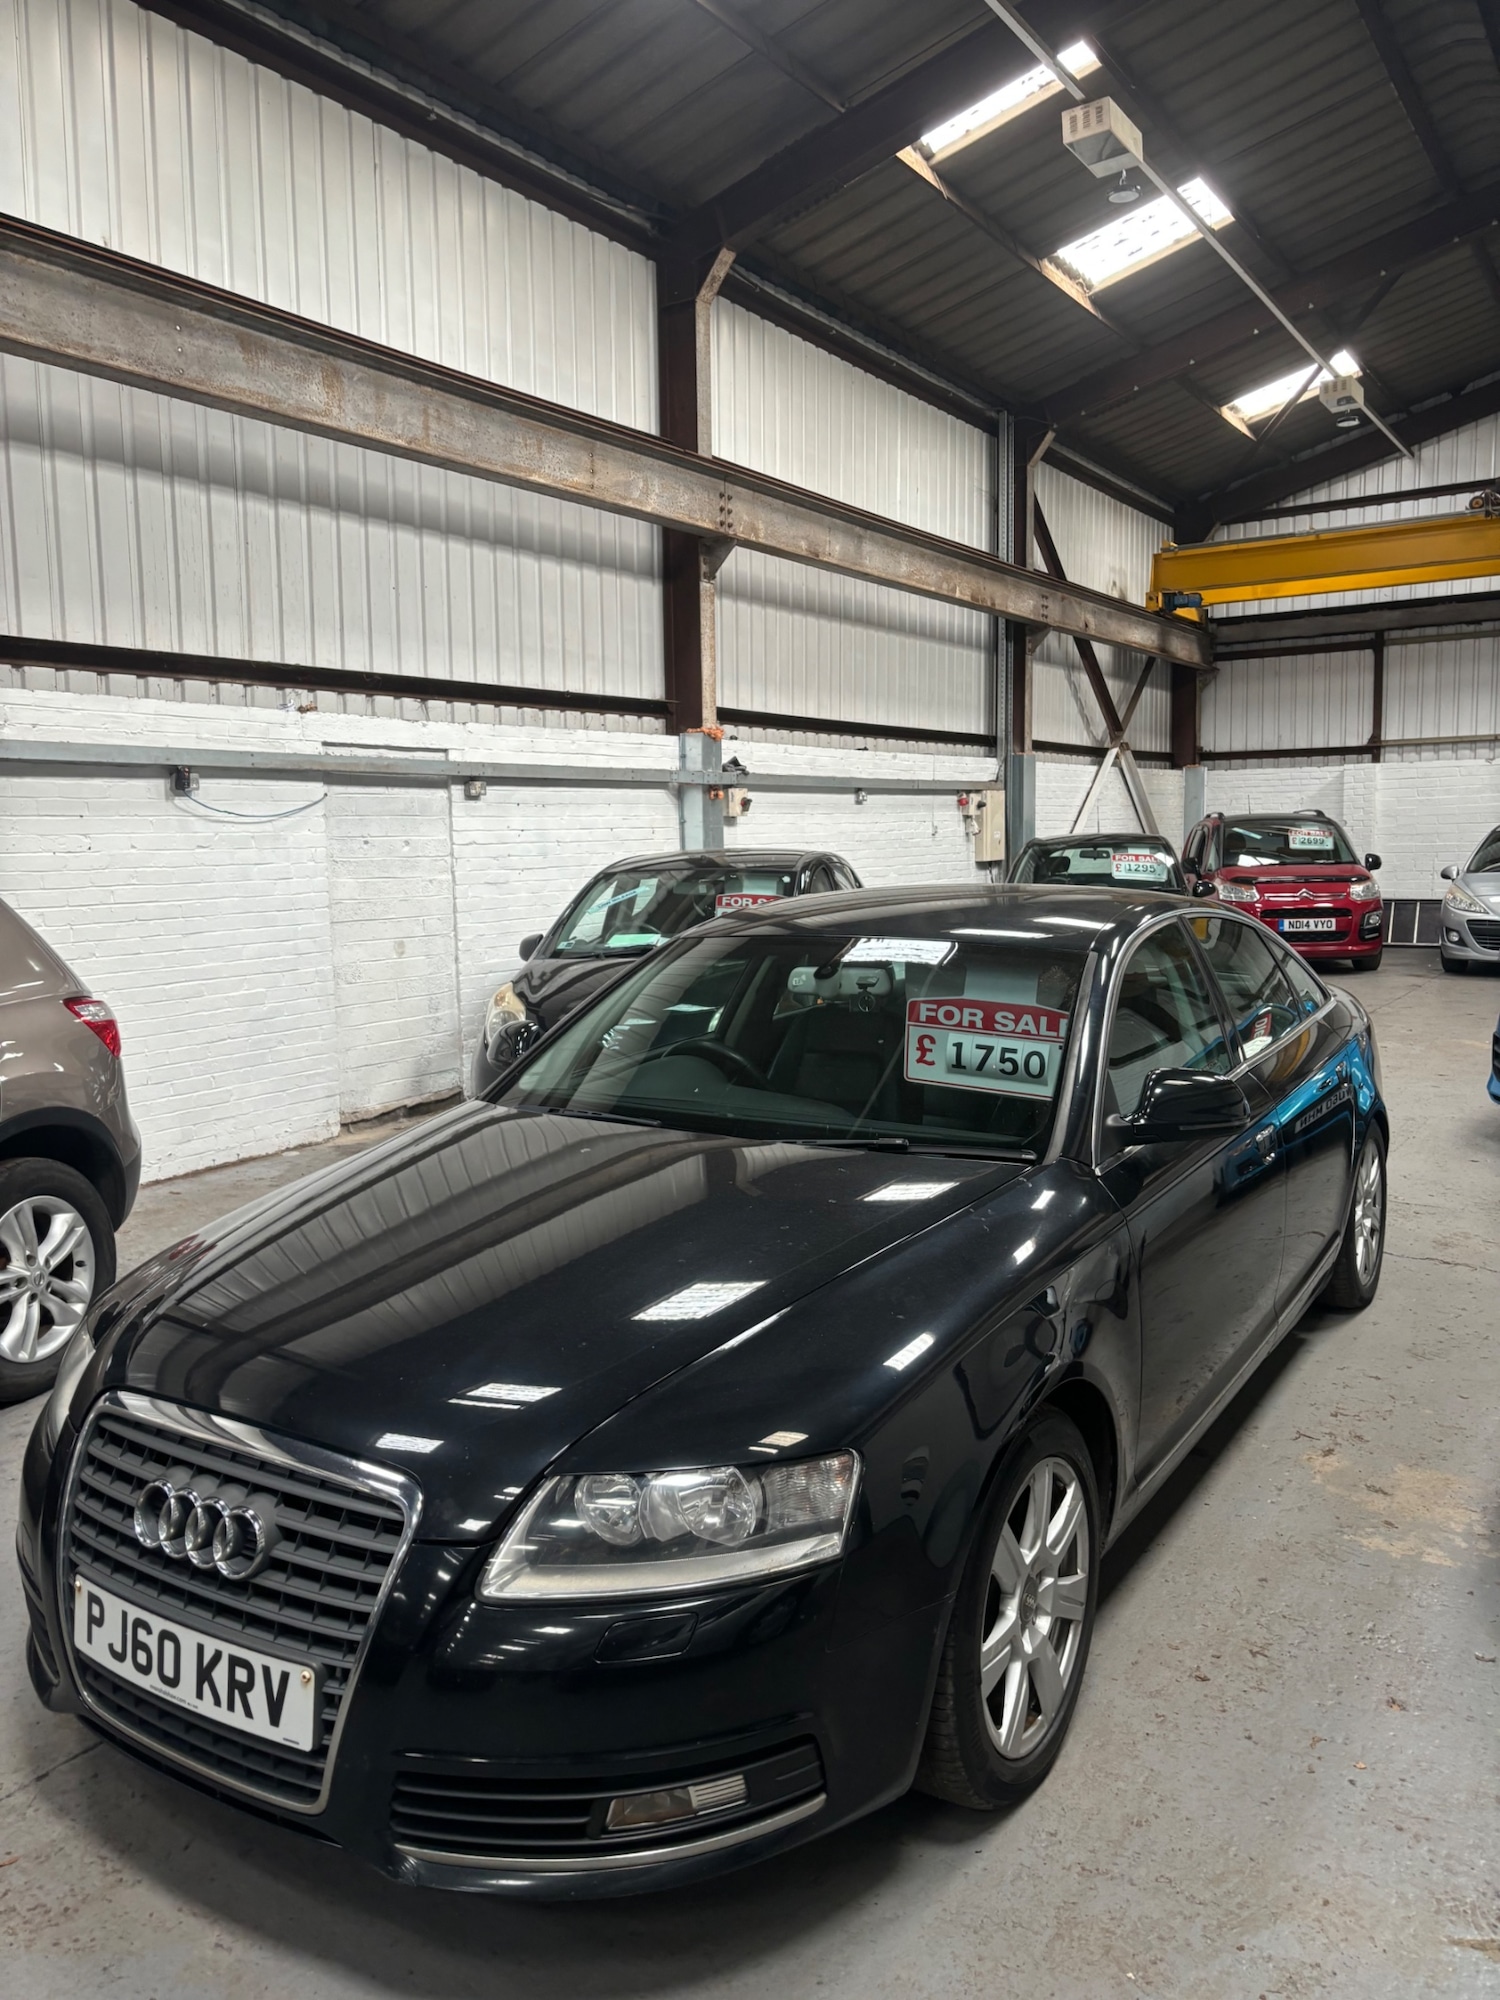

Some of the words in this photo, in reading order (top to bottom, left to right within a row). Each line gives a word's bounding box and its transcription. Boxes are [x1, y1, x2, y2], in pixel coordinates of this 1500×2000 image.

[1291, 837, 1298, 845] £
[1300, 837, 1325, 845] 2699
[1115, 863, 1122, 872] £
[1127, 863, 1156, 873] 1295
[722, 896, 753, 908] FOR
[1288, 920, 1310, 929] ND14
[1313, 920, 1333, 928] VYO
[919, 1003, 984, 1029] FOR
[915, 1034, 936, 1066] £
[951, 1042, 1046, 1079] 1750
[86, 1590, 181, 1689] PJ60
[195, 1642, 290, 1728] KRV
